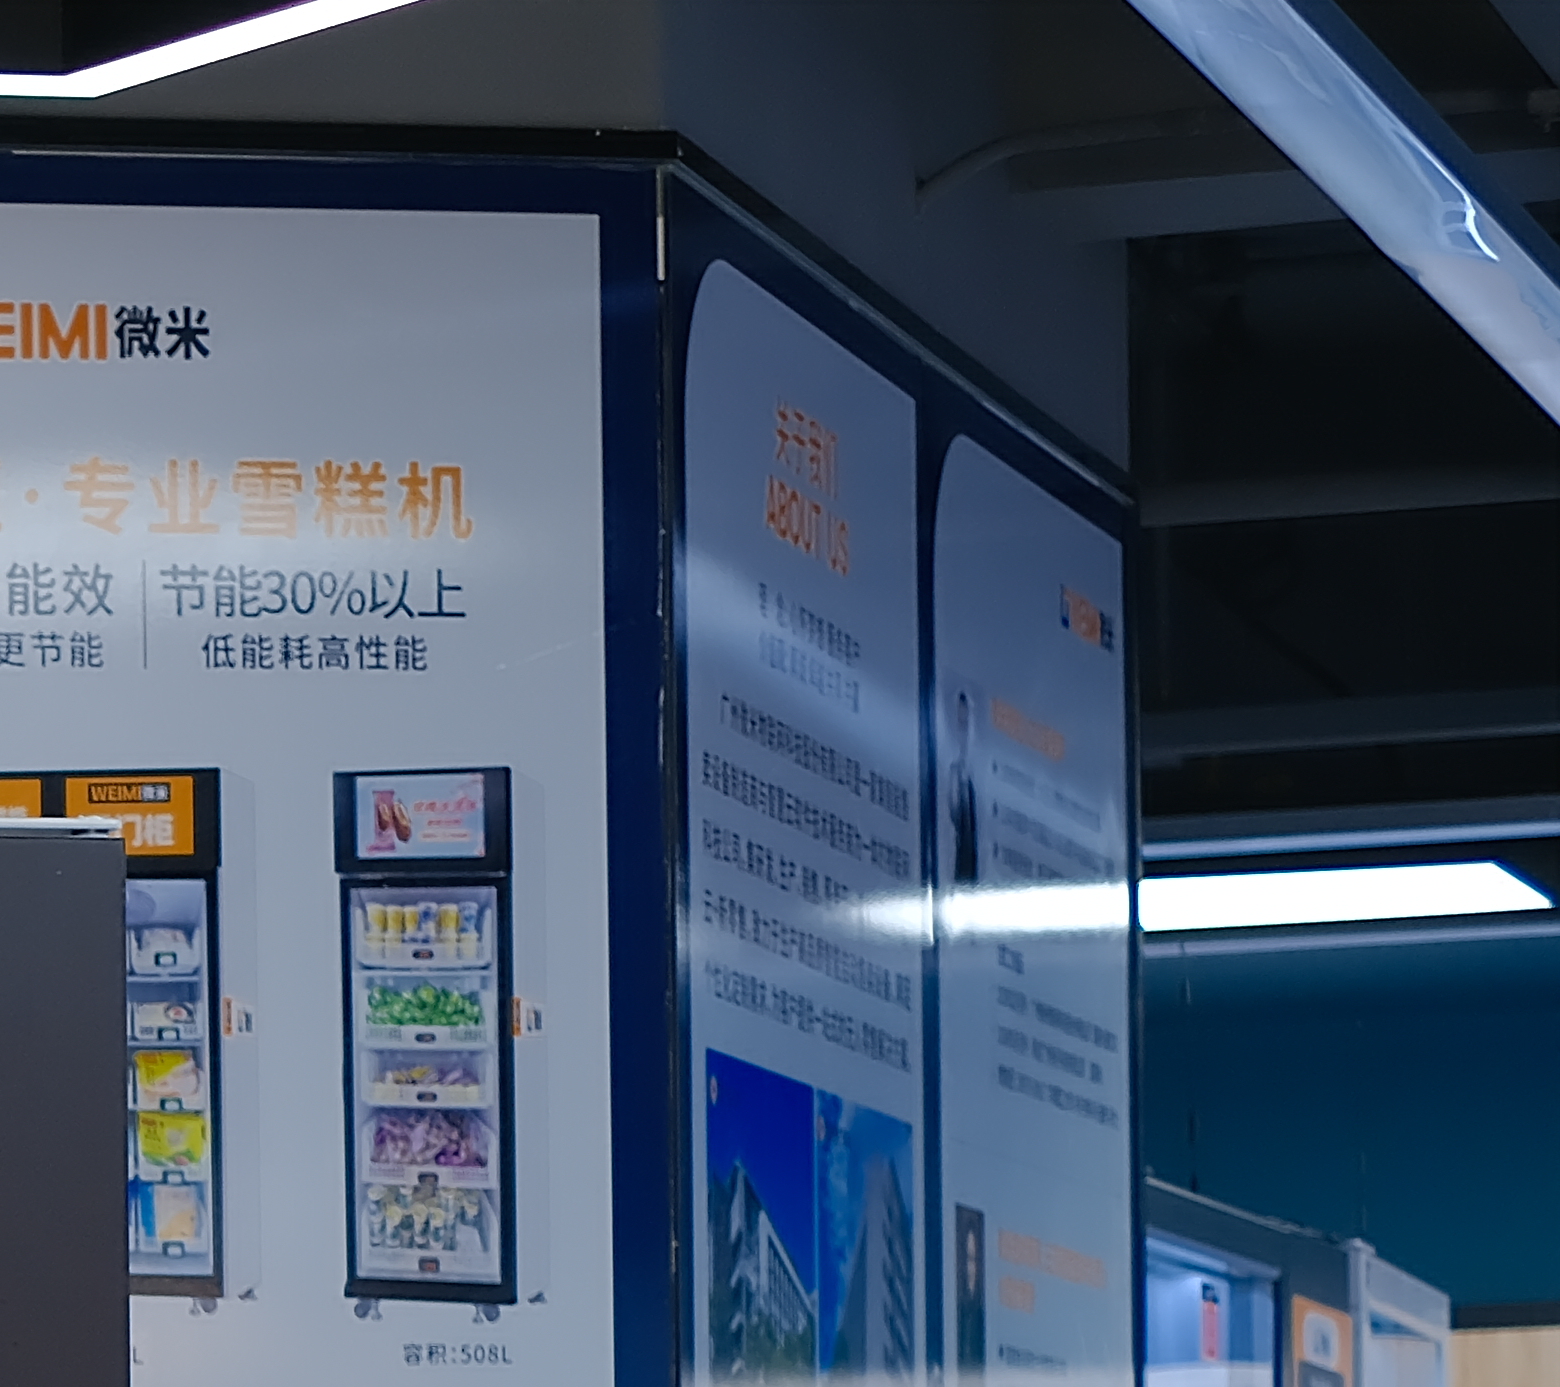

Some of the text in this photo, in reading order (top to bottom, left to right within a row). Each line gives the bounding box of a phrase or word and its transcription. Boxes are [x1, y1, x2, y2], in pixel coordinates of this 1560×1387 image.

[160, 565, 466, 621] 节能30%以上
[201, 633, 428, 672] 低能耗高性能
